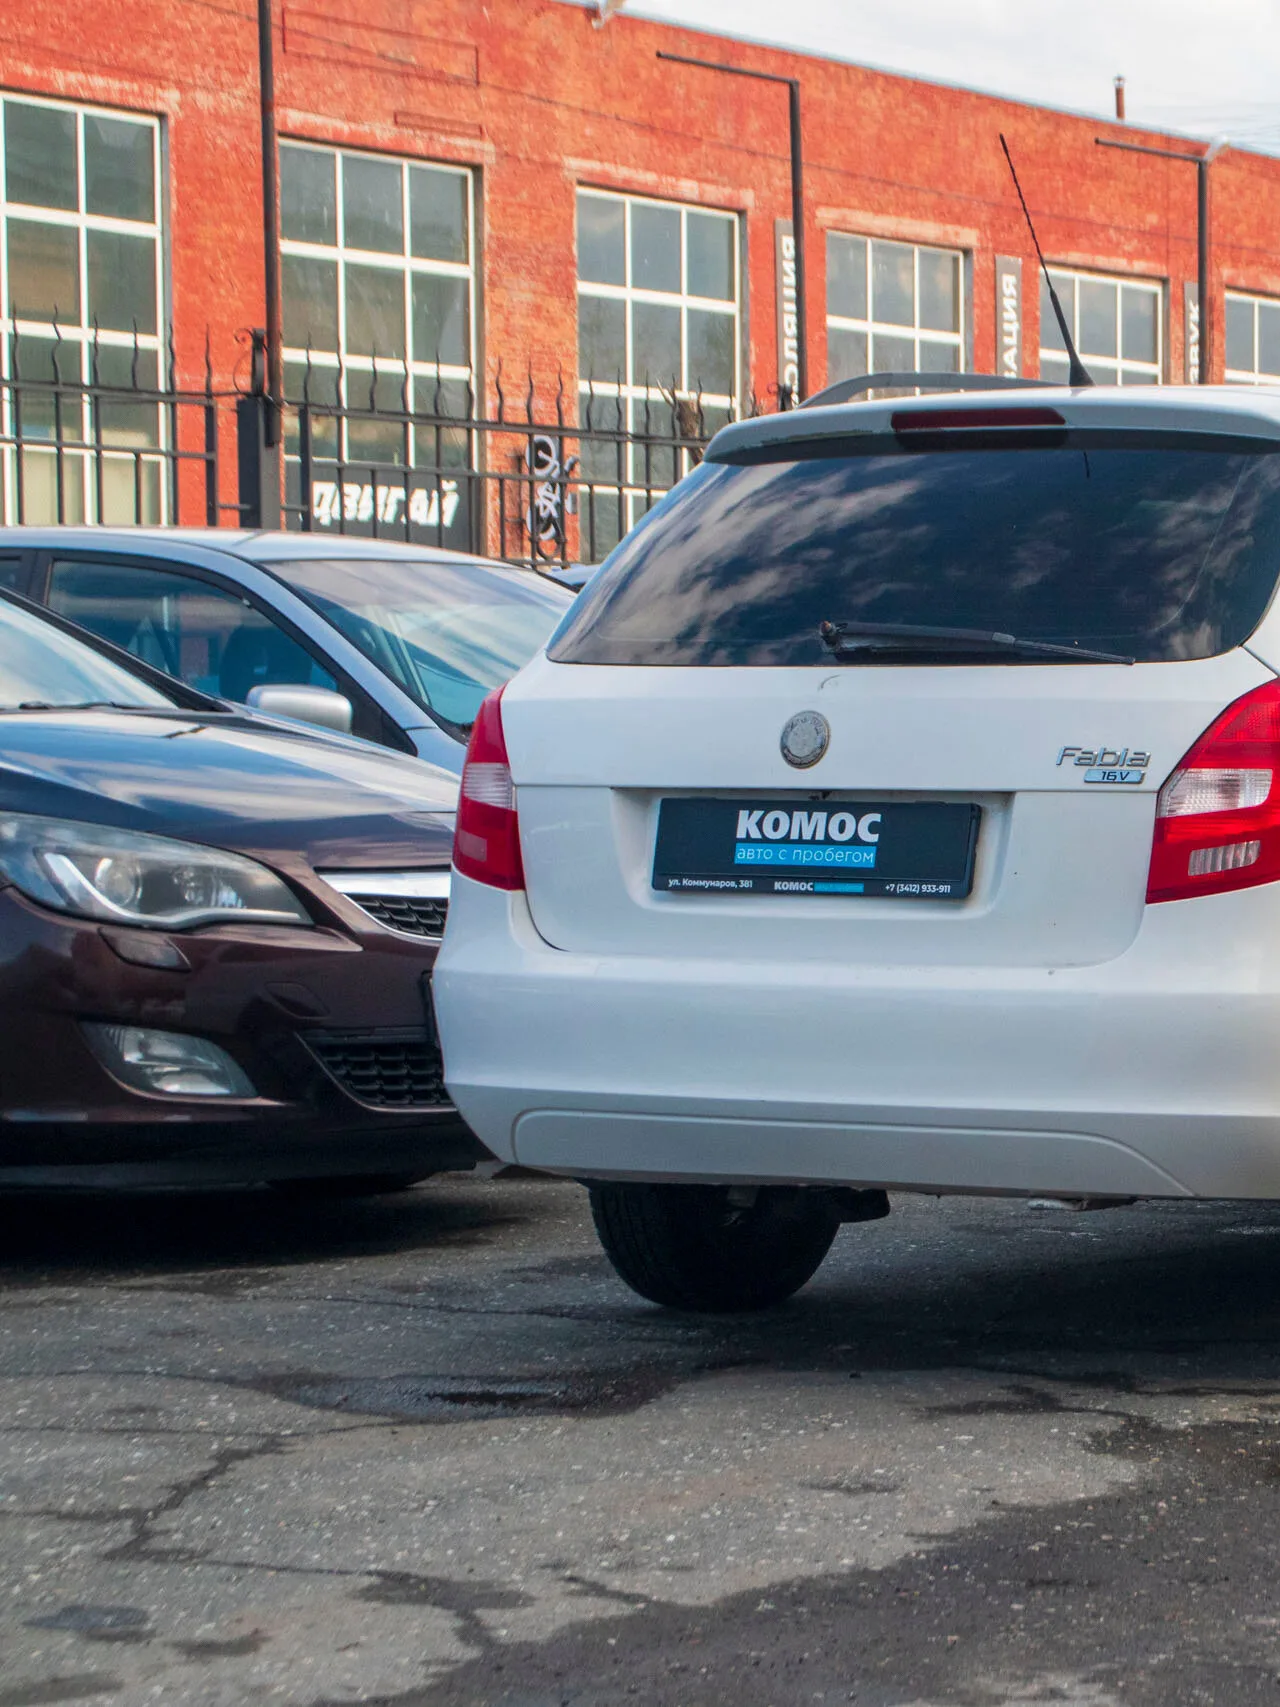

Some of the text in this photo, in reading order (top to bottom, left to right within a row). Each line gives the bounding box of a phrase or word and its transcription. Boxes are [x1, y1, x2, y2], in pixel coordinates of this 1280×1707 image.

[1056, 746, 1150, 767] Fabia
[736, 810, 881, 842] КОМОС
[737, 848, 874, 863] авто с пробегом
[668, 878, 753, 888] ул. Коммунаров, 381
[774, 881, 813, 891] КОМОС
[896, 883, 920, 893] (3412)
[921, 884, 951, 893] 933-911
